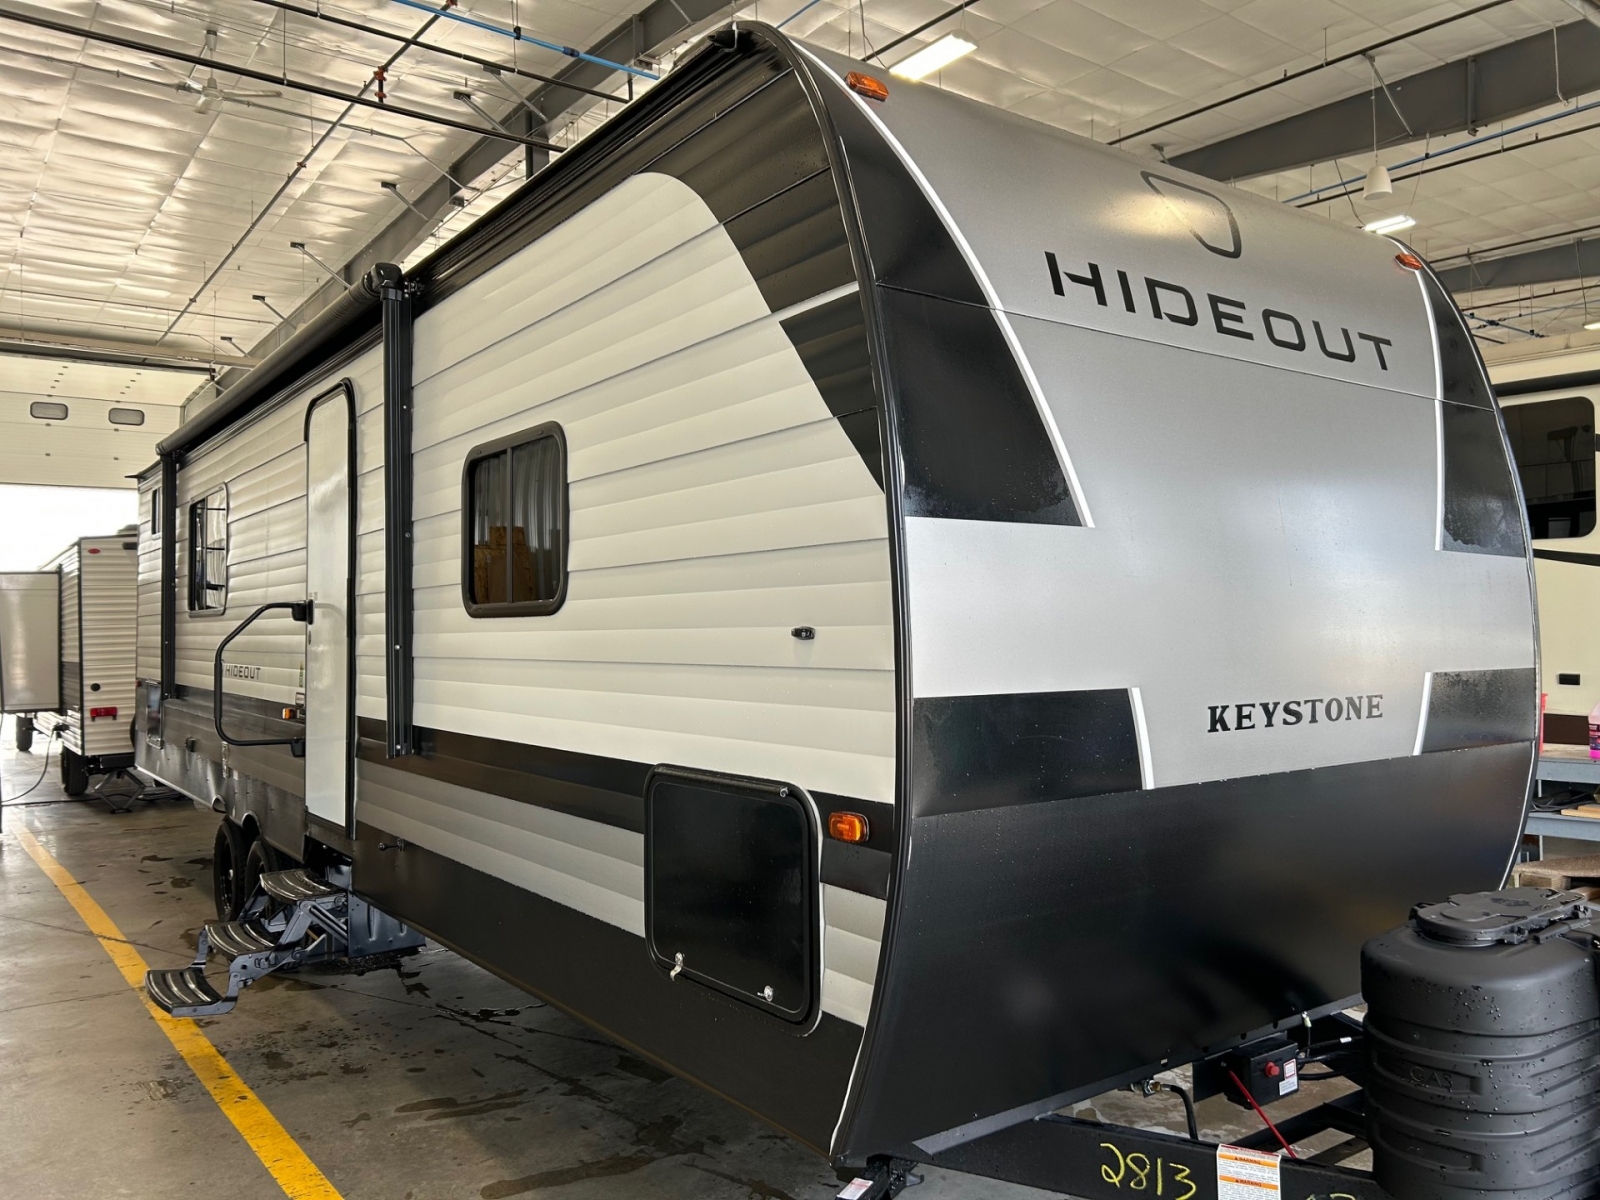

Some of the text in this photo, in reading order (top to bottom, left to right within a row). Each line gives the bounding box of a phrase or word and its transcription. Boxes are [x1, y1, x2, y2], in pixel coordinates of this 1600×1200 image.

[1044, 251, 1393, 371] HIDEOUT
[225, 664, 261, 680] HIDEOUT
[1207, 694, 1383, 733] KEYSTONE
[1410, 1066, 1453, 1089] GAS
[1099, 1142, 1197, 1200] 2813
[1239, 1157, 1261, 1165] WARNING
[1240, 1179, 1262, 1187] WARNING
